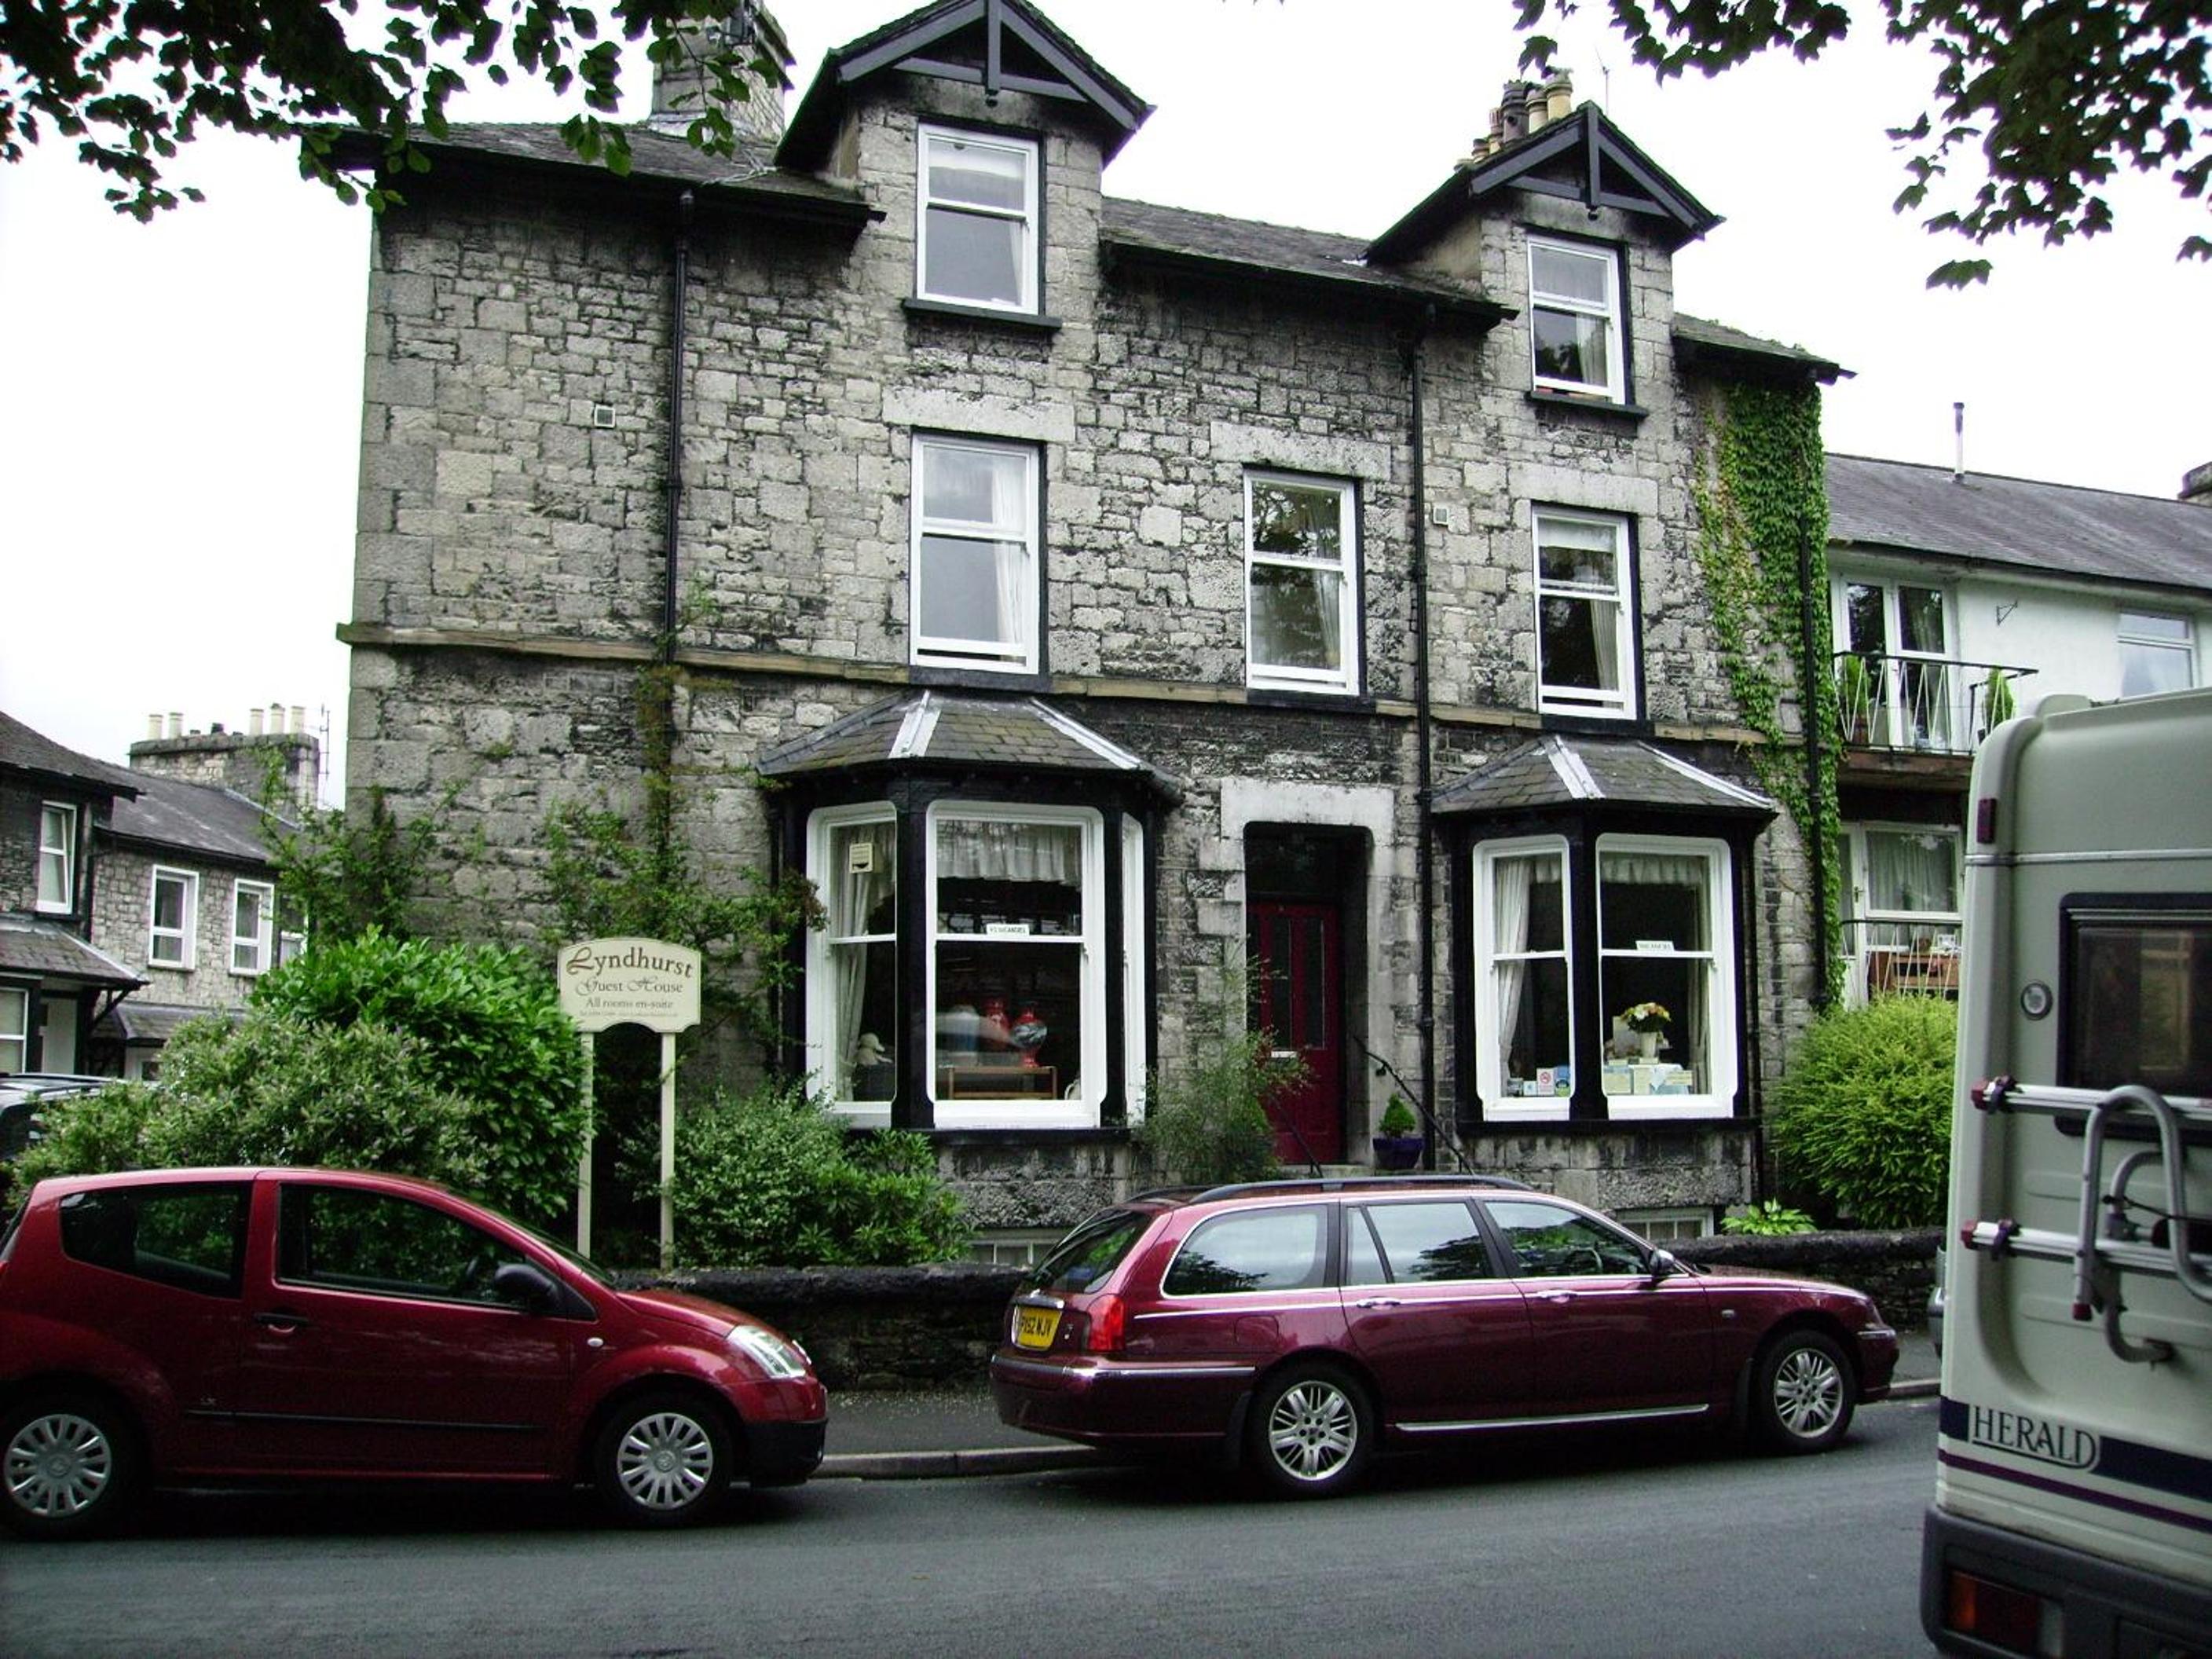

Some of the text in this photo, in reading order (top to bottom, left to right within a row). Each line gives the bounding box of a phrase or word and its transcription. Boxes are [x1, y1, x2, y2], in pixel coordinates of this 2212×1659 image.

[566, 947, 693, 978] Lyndhurst
[575, 975, 683, 996] Guest House
[586, 997, 601, 1008] All
[635, 999, 673, 1009] en-suite
[1972, 1405, 2097, 1468] HERALD
